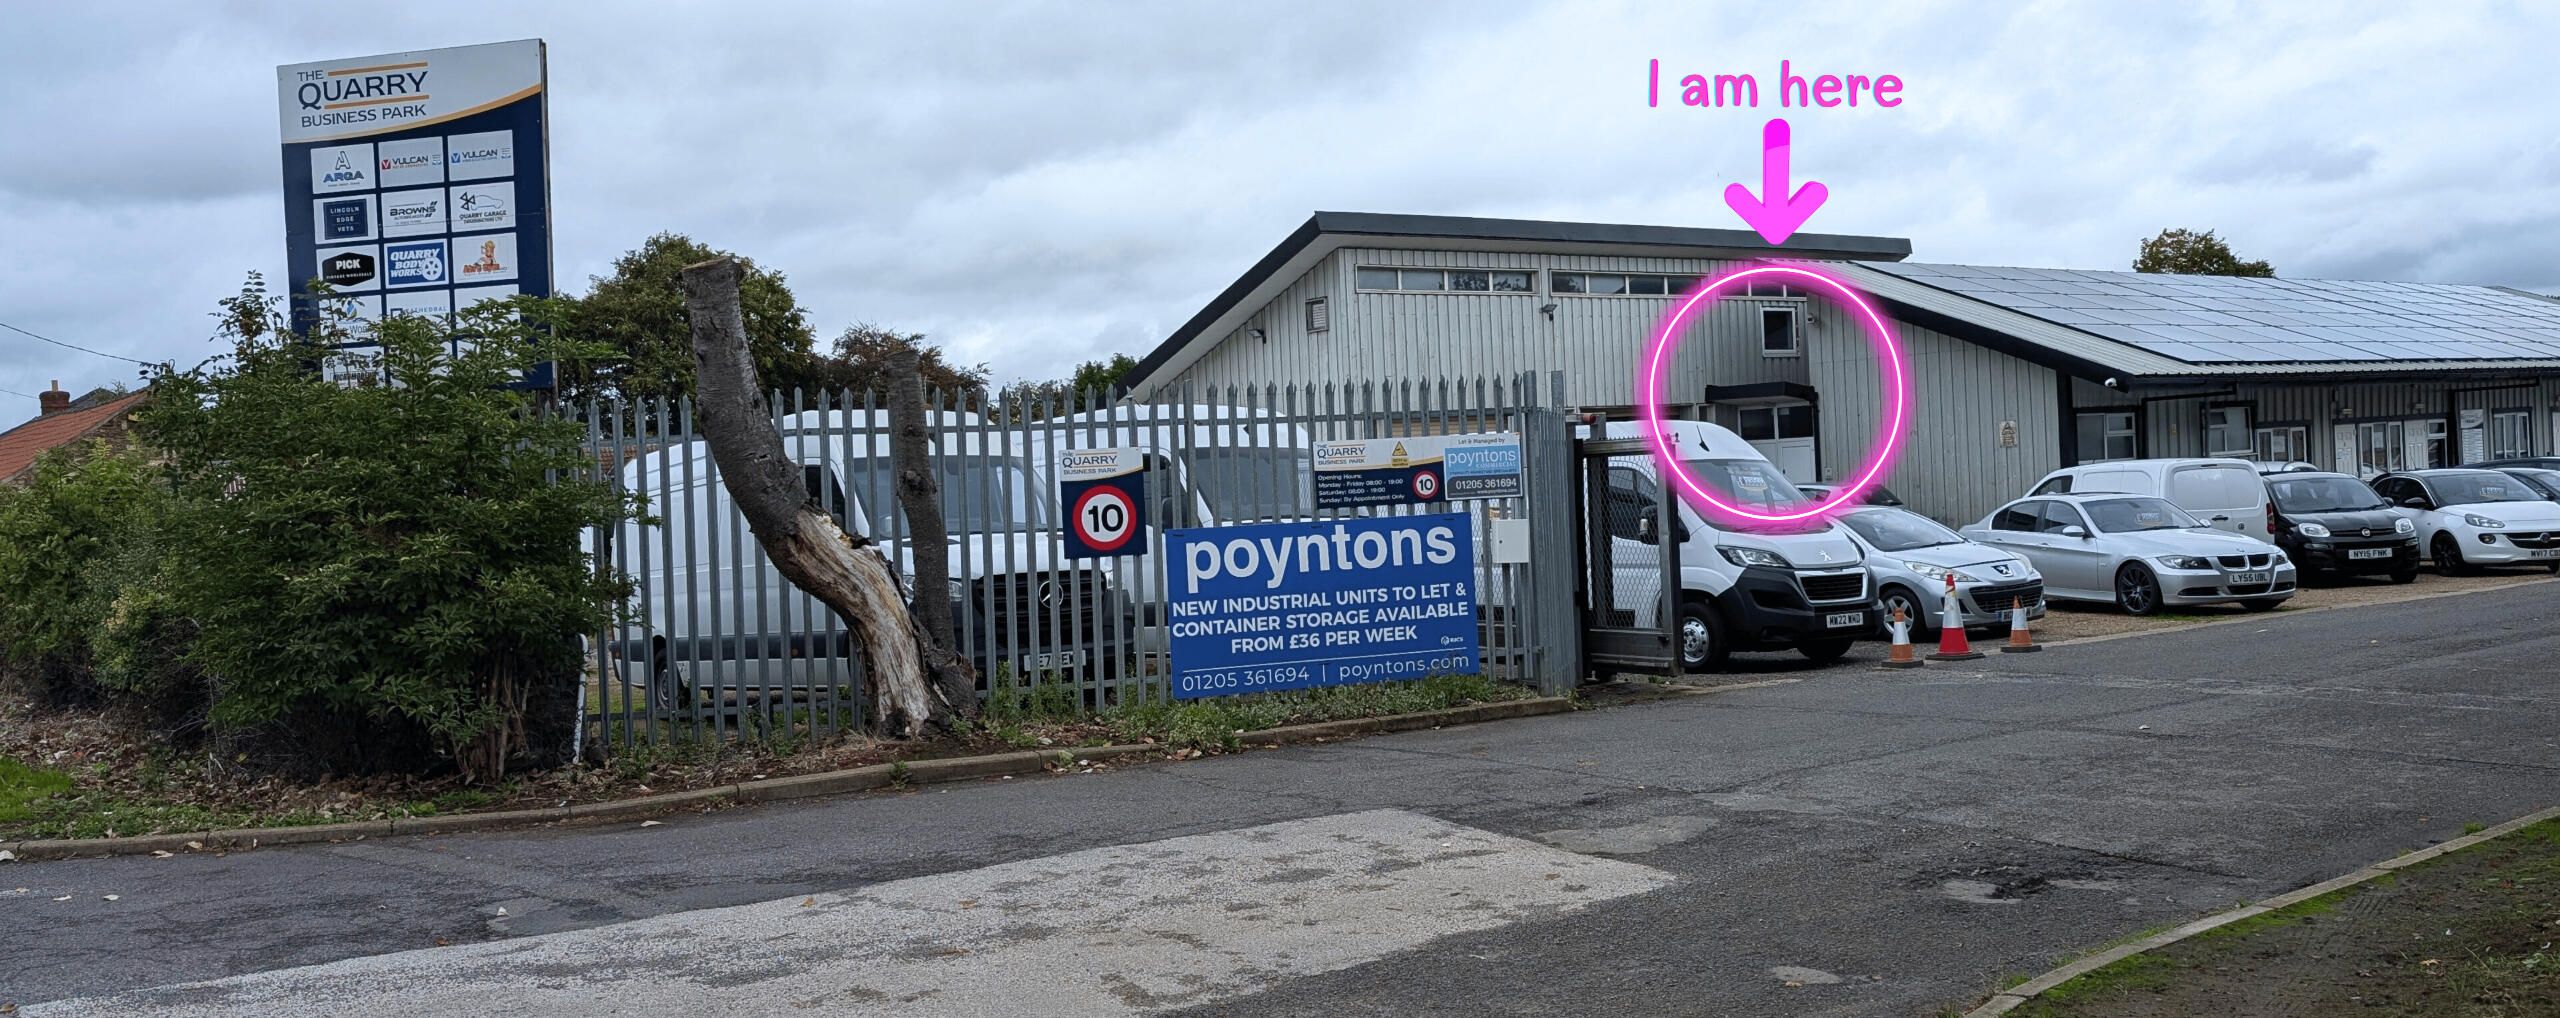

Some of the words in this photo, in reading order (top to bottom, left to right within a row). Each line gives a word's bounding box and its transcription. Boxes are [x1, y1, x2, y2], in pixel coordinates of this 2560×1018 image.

[297, 70, 324, 81] THE
[298, 71, 428, 110] QUARRY
[301, 109, 377, 127] BUSINESS
[382, 104, 427, 119] PARK
[392, 155, 429, 165] VULCAN
[462, 149, 498, 159] VULCAN
[390, 206, 437, 216] BROWNS
[459, 211, 483, 220] QUARRY
[484, 209, 507, 217] GARAGE
[390, 248, 441, 261] QUARRY
[335, 258, 361, 270] PICK
[394, 259, 427, 270] BODY
[390, 267, 423, 278] WORKS
[1317, 446, 1367, 460] QUARRY
[1447, 449, 1516, 468] poyntons
[1062, 455, 1118, 469] QUARRY
[1318, 481, 1341, 489] Monday
[1346, 480, 1365, 488] Friday
[1418, 479, 1434, 491] 10
[1455, 479, 1483, 490] 01205
[1484, 478, 1517, 488] 361694
[1353, 494, 1391, 502] Appointment
[1088, 503, 1124, 533] 10
[1186, 524, 1456, 594] poyntons
[2353, 550, 2371, 558] NY15
[2232, 573, 2253, 583] LY55
[1173, 600, 1218, 617] NEW
[1223, 592, 1331, 614] INDUSTRIAL
[1335, 588, 1388, 606] UNITS
[1392, 586, 1416, 601] TO
[1421, 583, 1450, 599] LET
[1455, 582, 1466, 597] &
[1172, 616, 1281, 638] CONTAINER
[1286, 609, 1370, 629] STORAGE
[1374, 601, 1469, 623] AVAILABLE
[1231, 636, 1284, 654] FROM
[1289, 633, 1320, 649] £36
[1325, 629, 1360, 646] PER
[1364, 625, 1418, 643] WEEK
[1182, 672, 1238, 692] 01205
[1243, 666, 1309, 686] 361694
[1339, 655, 1470, 681] poyntons.com
